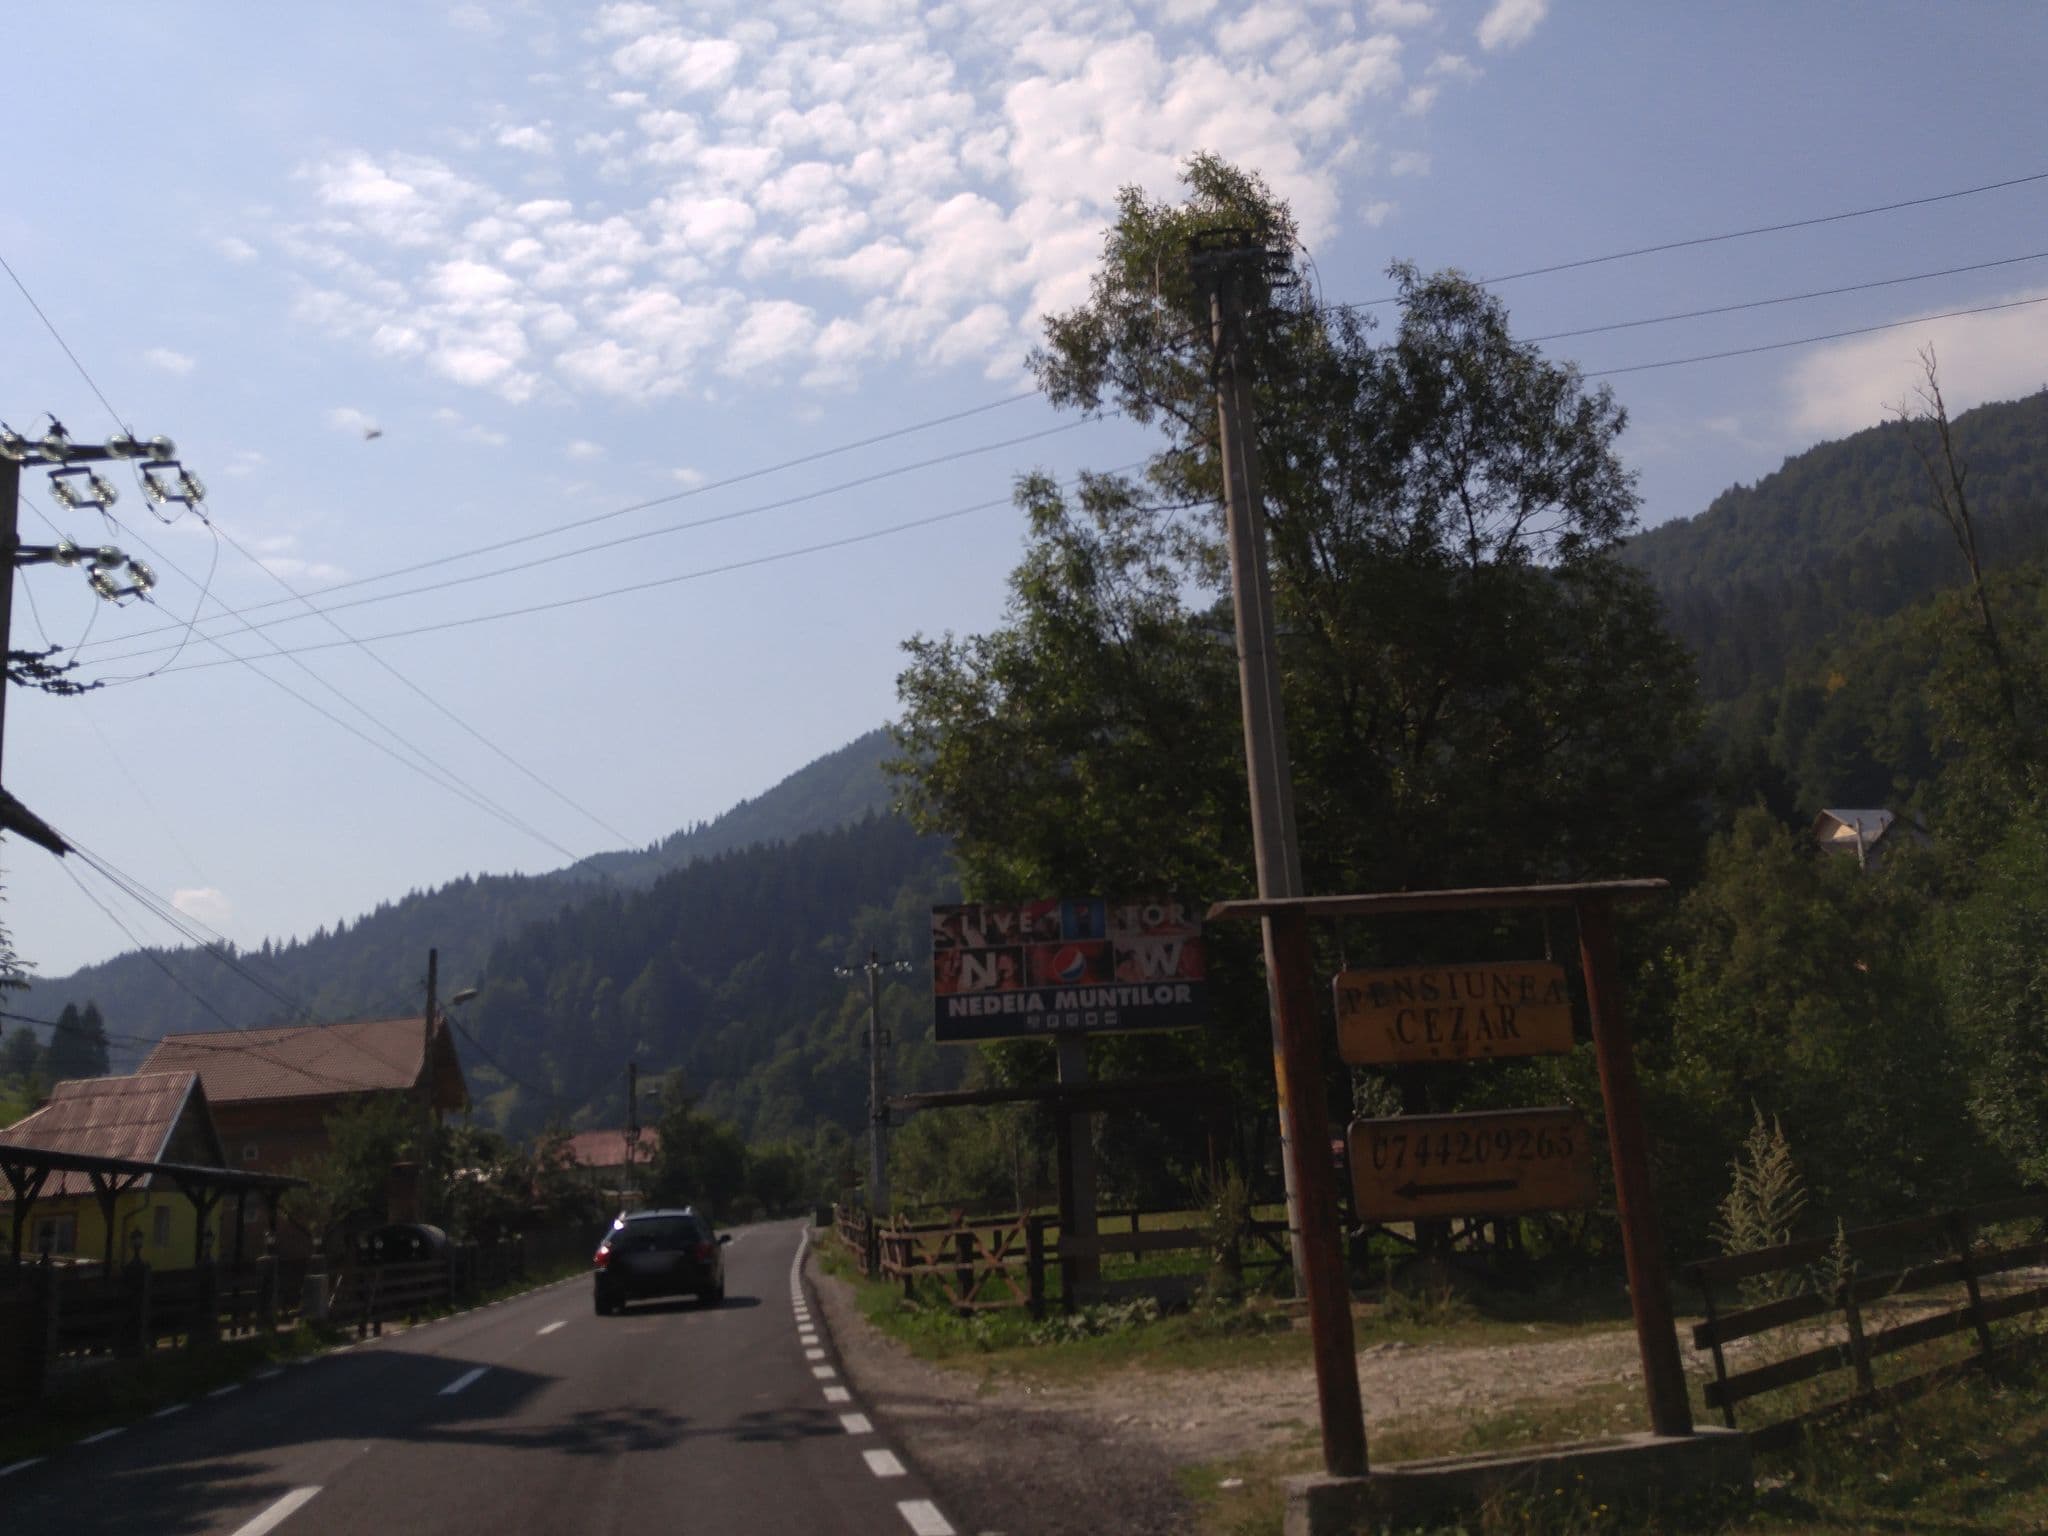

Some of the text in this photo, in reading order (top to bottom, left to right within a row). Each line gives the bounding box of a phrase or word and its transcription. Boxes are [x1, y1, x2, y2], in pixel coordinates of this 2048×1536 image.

[948, 983, 1193, 1017] NEDEIA MUNTILOR
[1341, 971, 1563, 1014] PENSIUNEA
[1395, 1004, 1521, 1044] CEZAR
[1372, 1126, 1573, 1171] 0744209265
